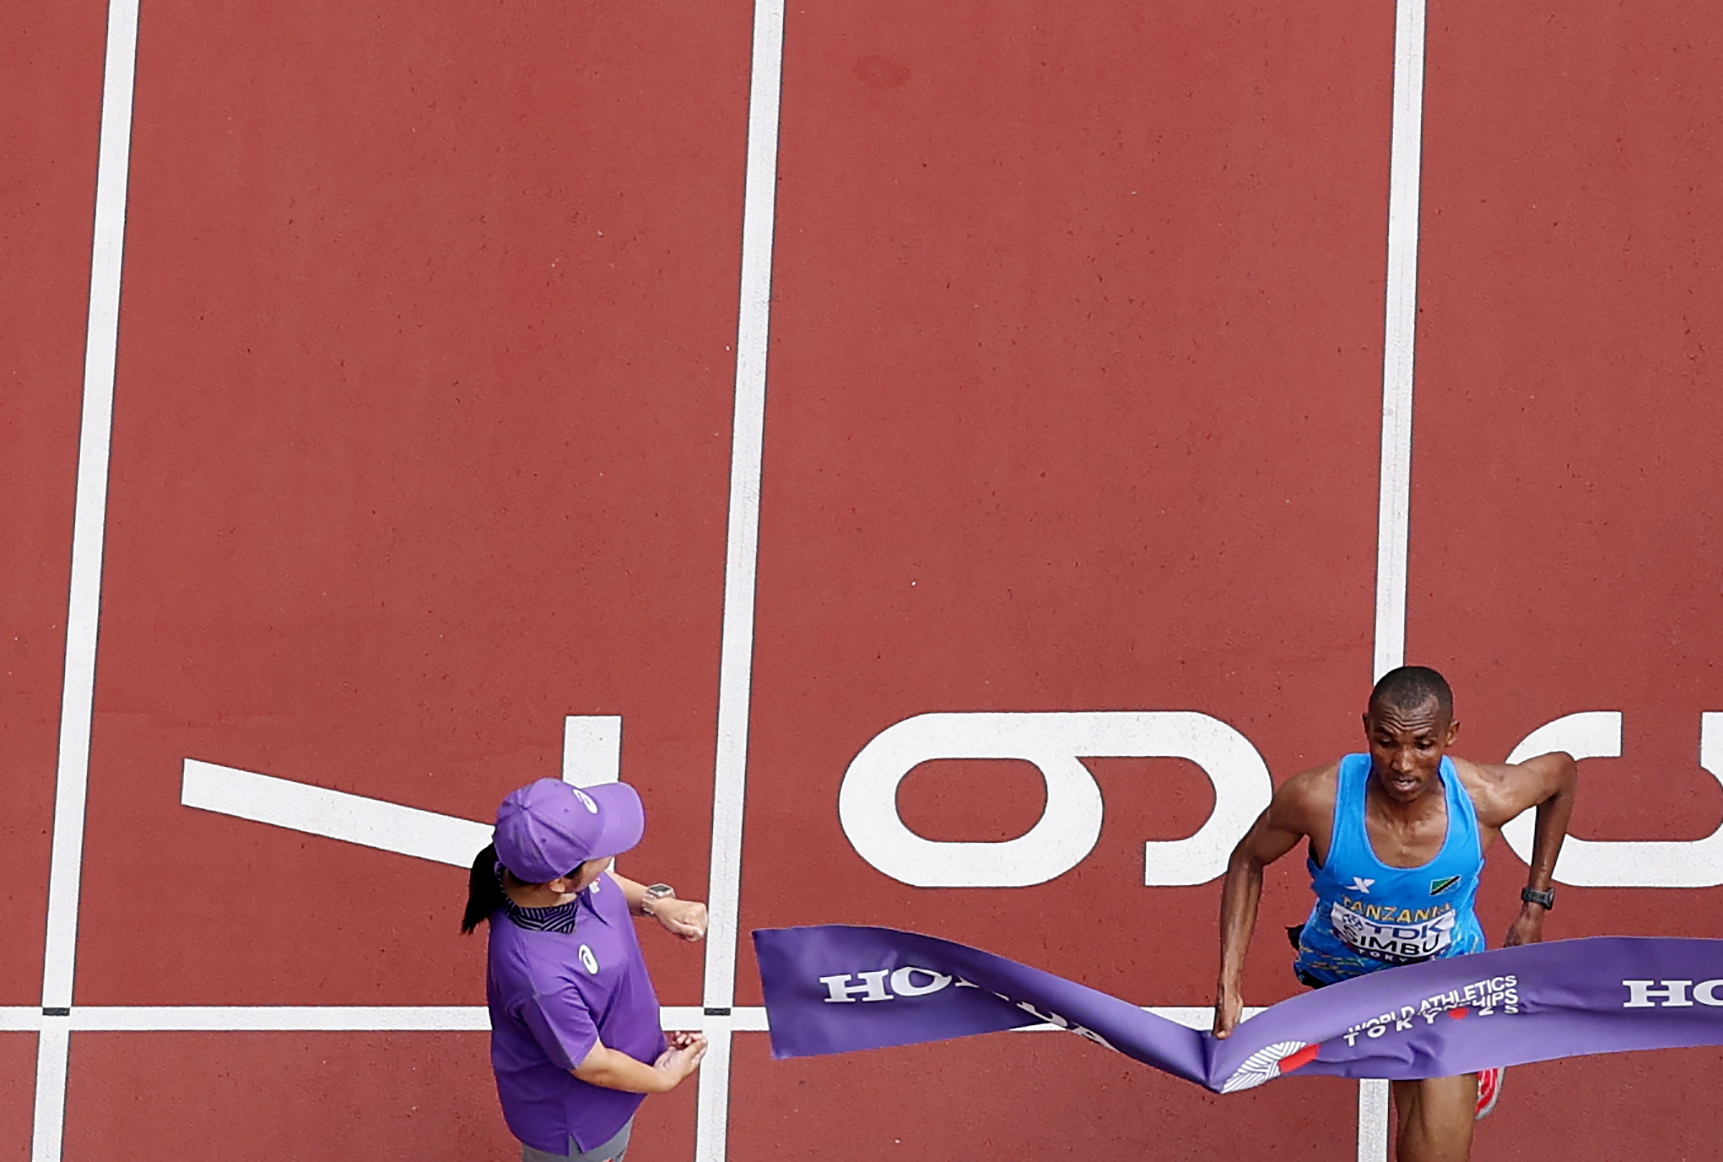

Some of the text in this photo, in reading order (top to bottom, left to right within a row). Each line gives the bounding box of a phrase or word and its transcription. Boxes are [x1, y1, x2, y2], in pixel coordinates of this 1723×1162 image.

[838, 711, 1272, 888] 6
[1343, 925, 1440, 956] SIMBU
[1364, 917, 1446, 940] TDK
[1418, 975, 1518, 1012] ATHLETICS
